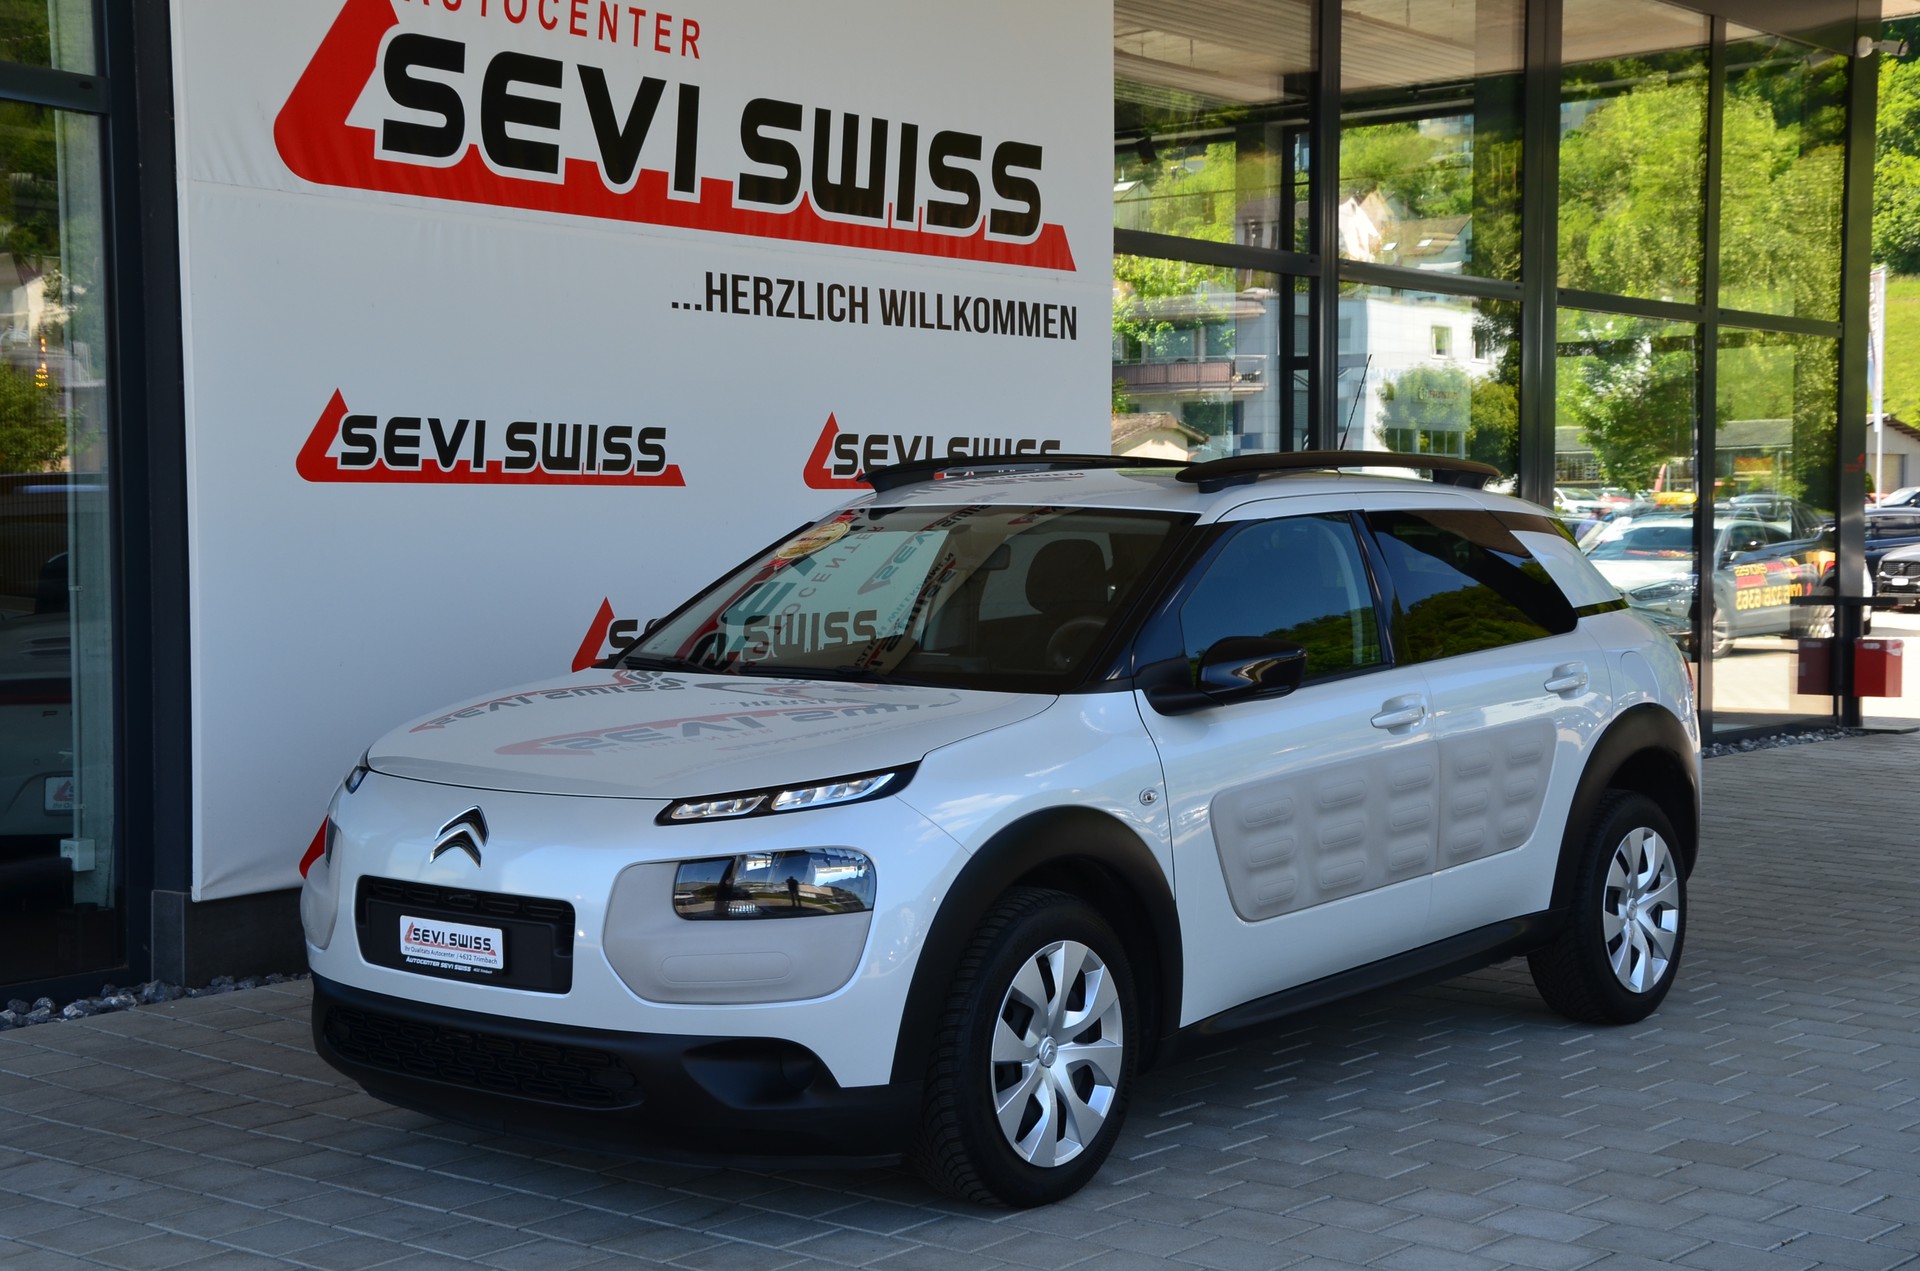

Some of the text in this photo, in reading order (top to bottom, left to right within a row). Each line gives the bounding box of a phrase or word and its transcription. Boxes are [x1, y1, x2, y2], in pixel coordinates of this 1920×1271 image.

[405, 0, 700, 59] OCENTER
[382, 33, 1043, 237] SEVI SWISS
[671, 271, 1077, 340] ...HERZLICH WILLKOMMEN
[340, 414, 666, 473] SEVI SWISS
[412, 927, 492, 951] SEVI SWISS
[431, 949, 455, 958] Autocenter
[459, 953, 472, 961] 4632
[473, 955, 498, 965] Trimbach
